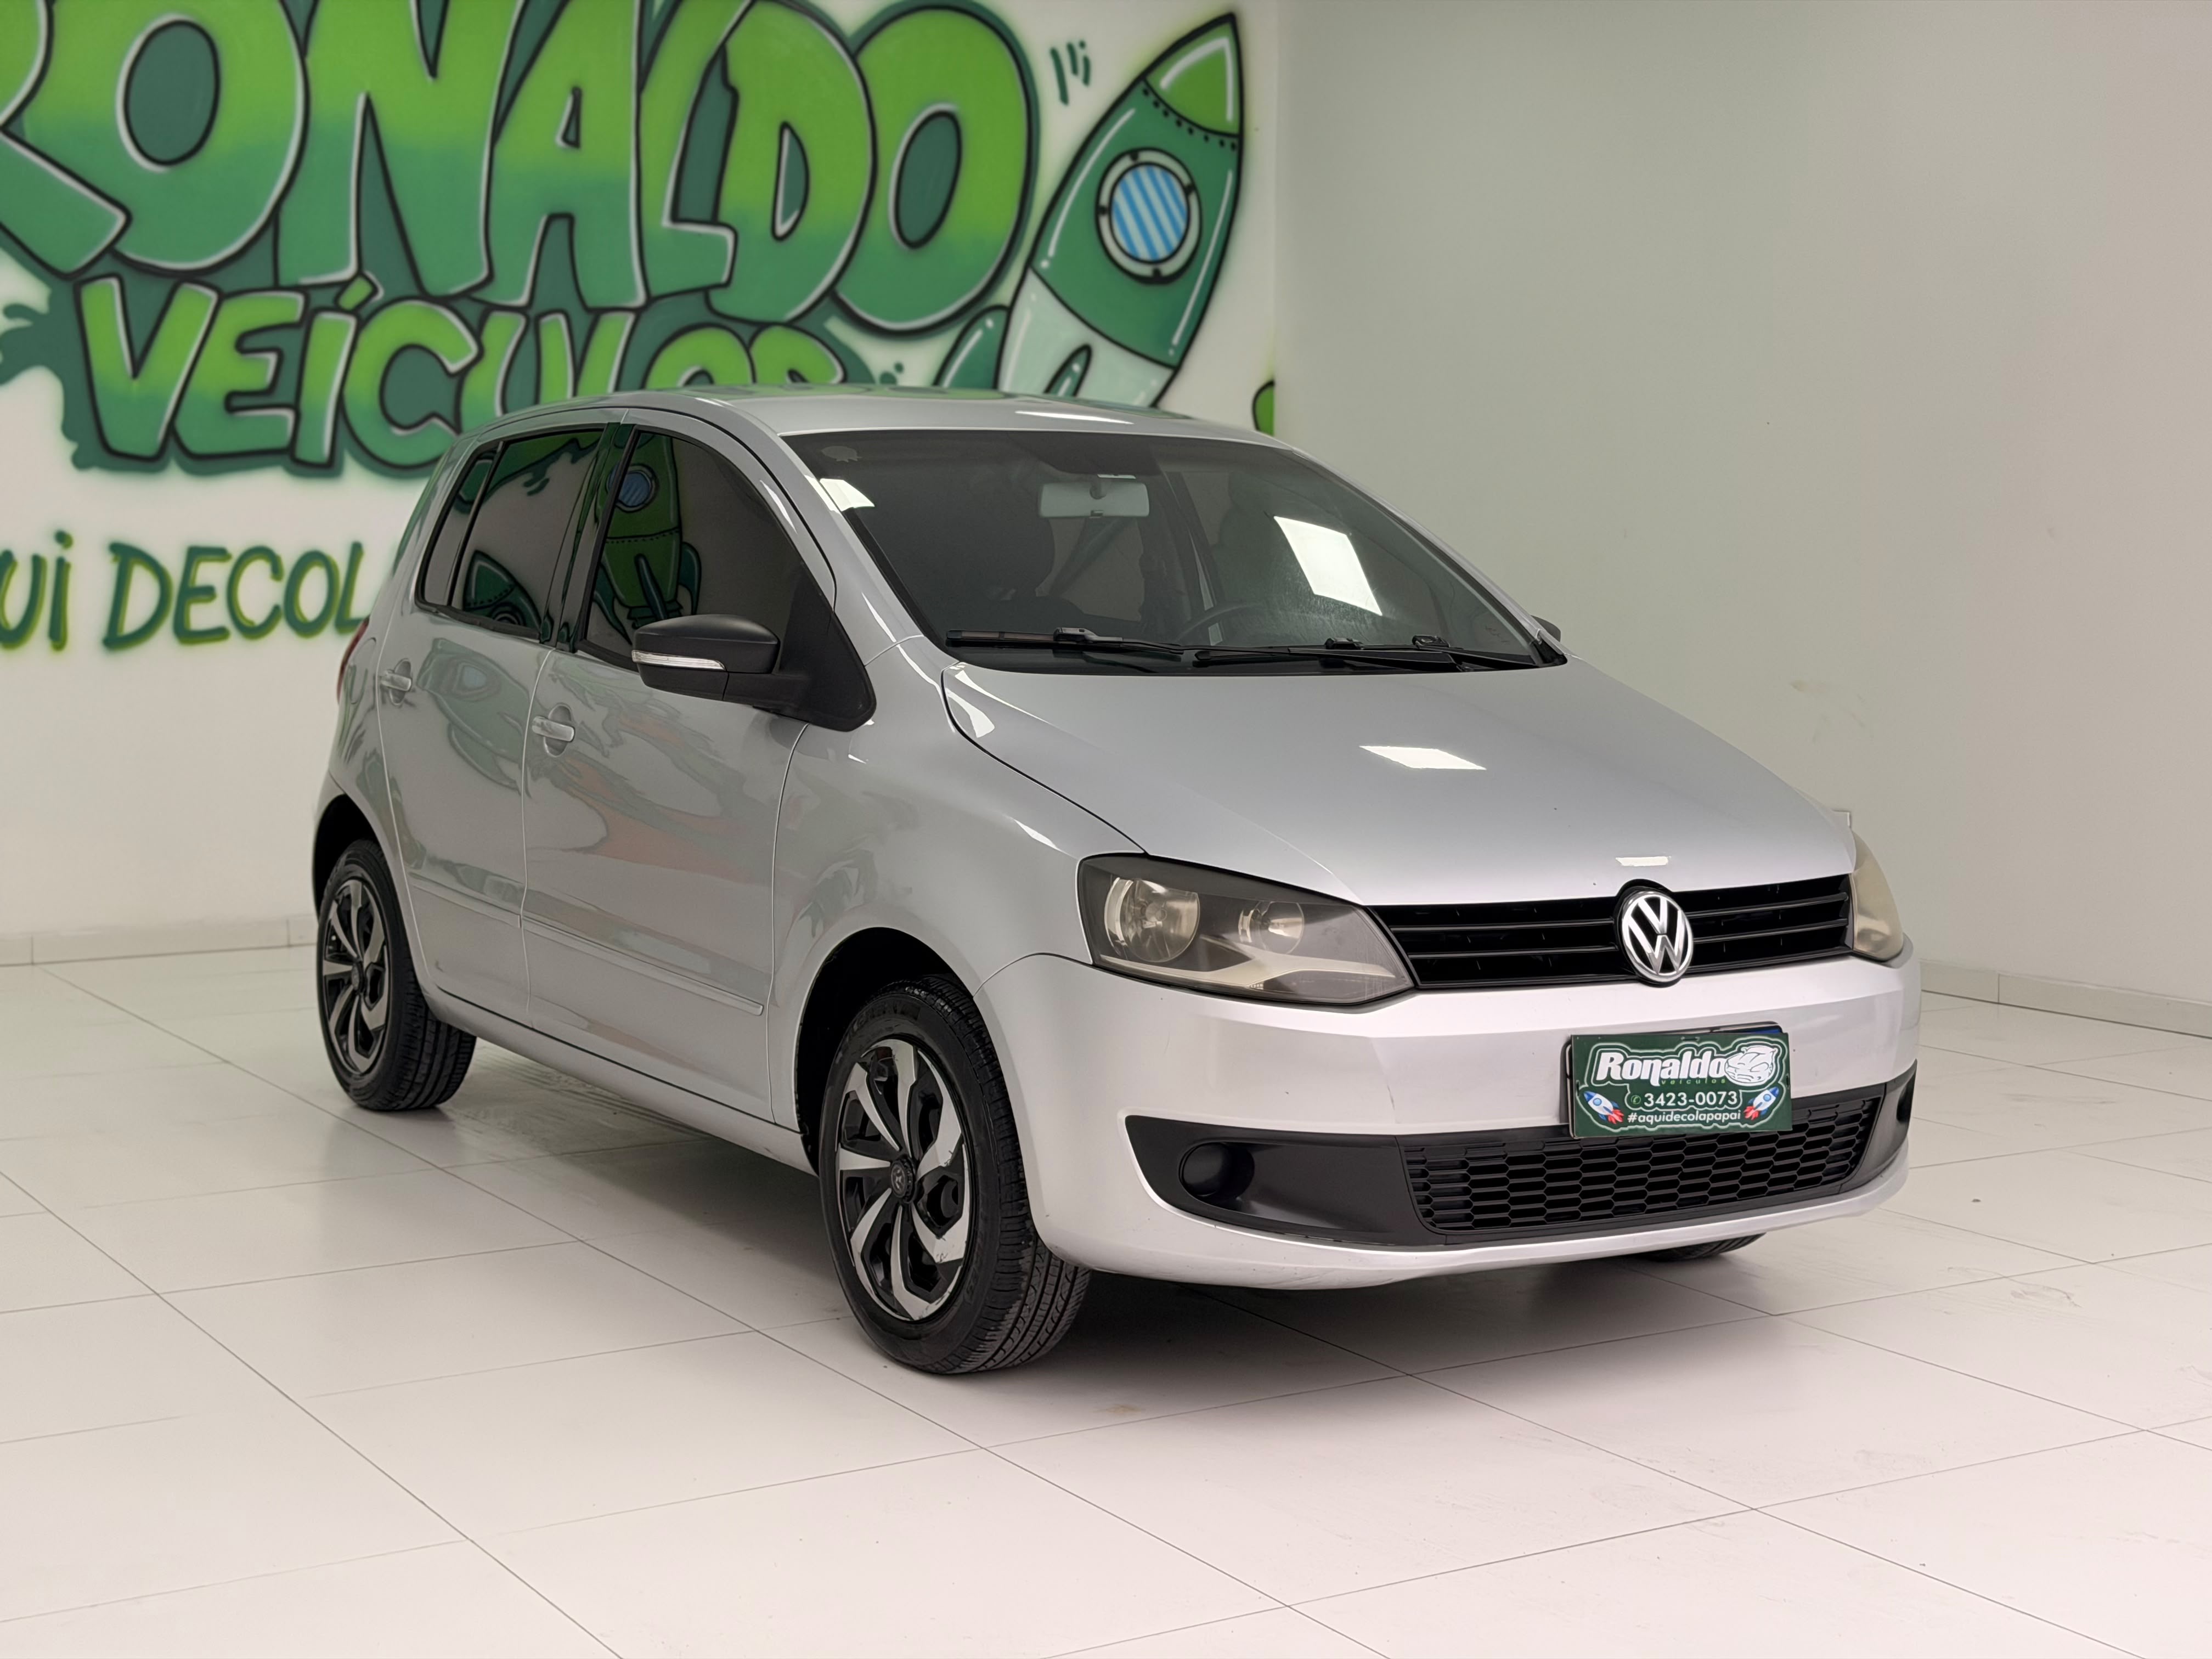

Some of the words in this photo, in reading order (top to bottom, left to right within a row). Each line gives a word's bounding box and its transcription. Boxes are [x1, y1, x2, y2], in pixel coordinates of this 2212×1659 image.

[1596, 1051, 1726, 1086] Ronaldo
[1644, 1091, 1737, 1107] 3423-0073
[1627, 1109, 1741, 1125] #aquidecolapapai
